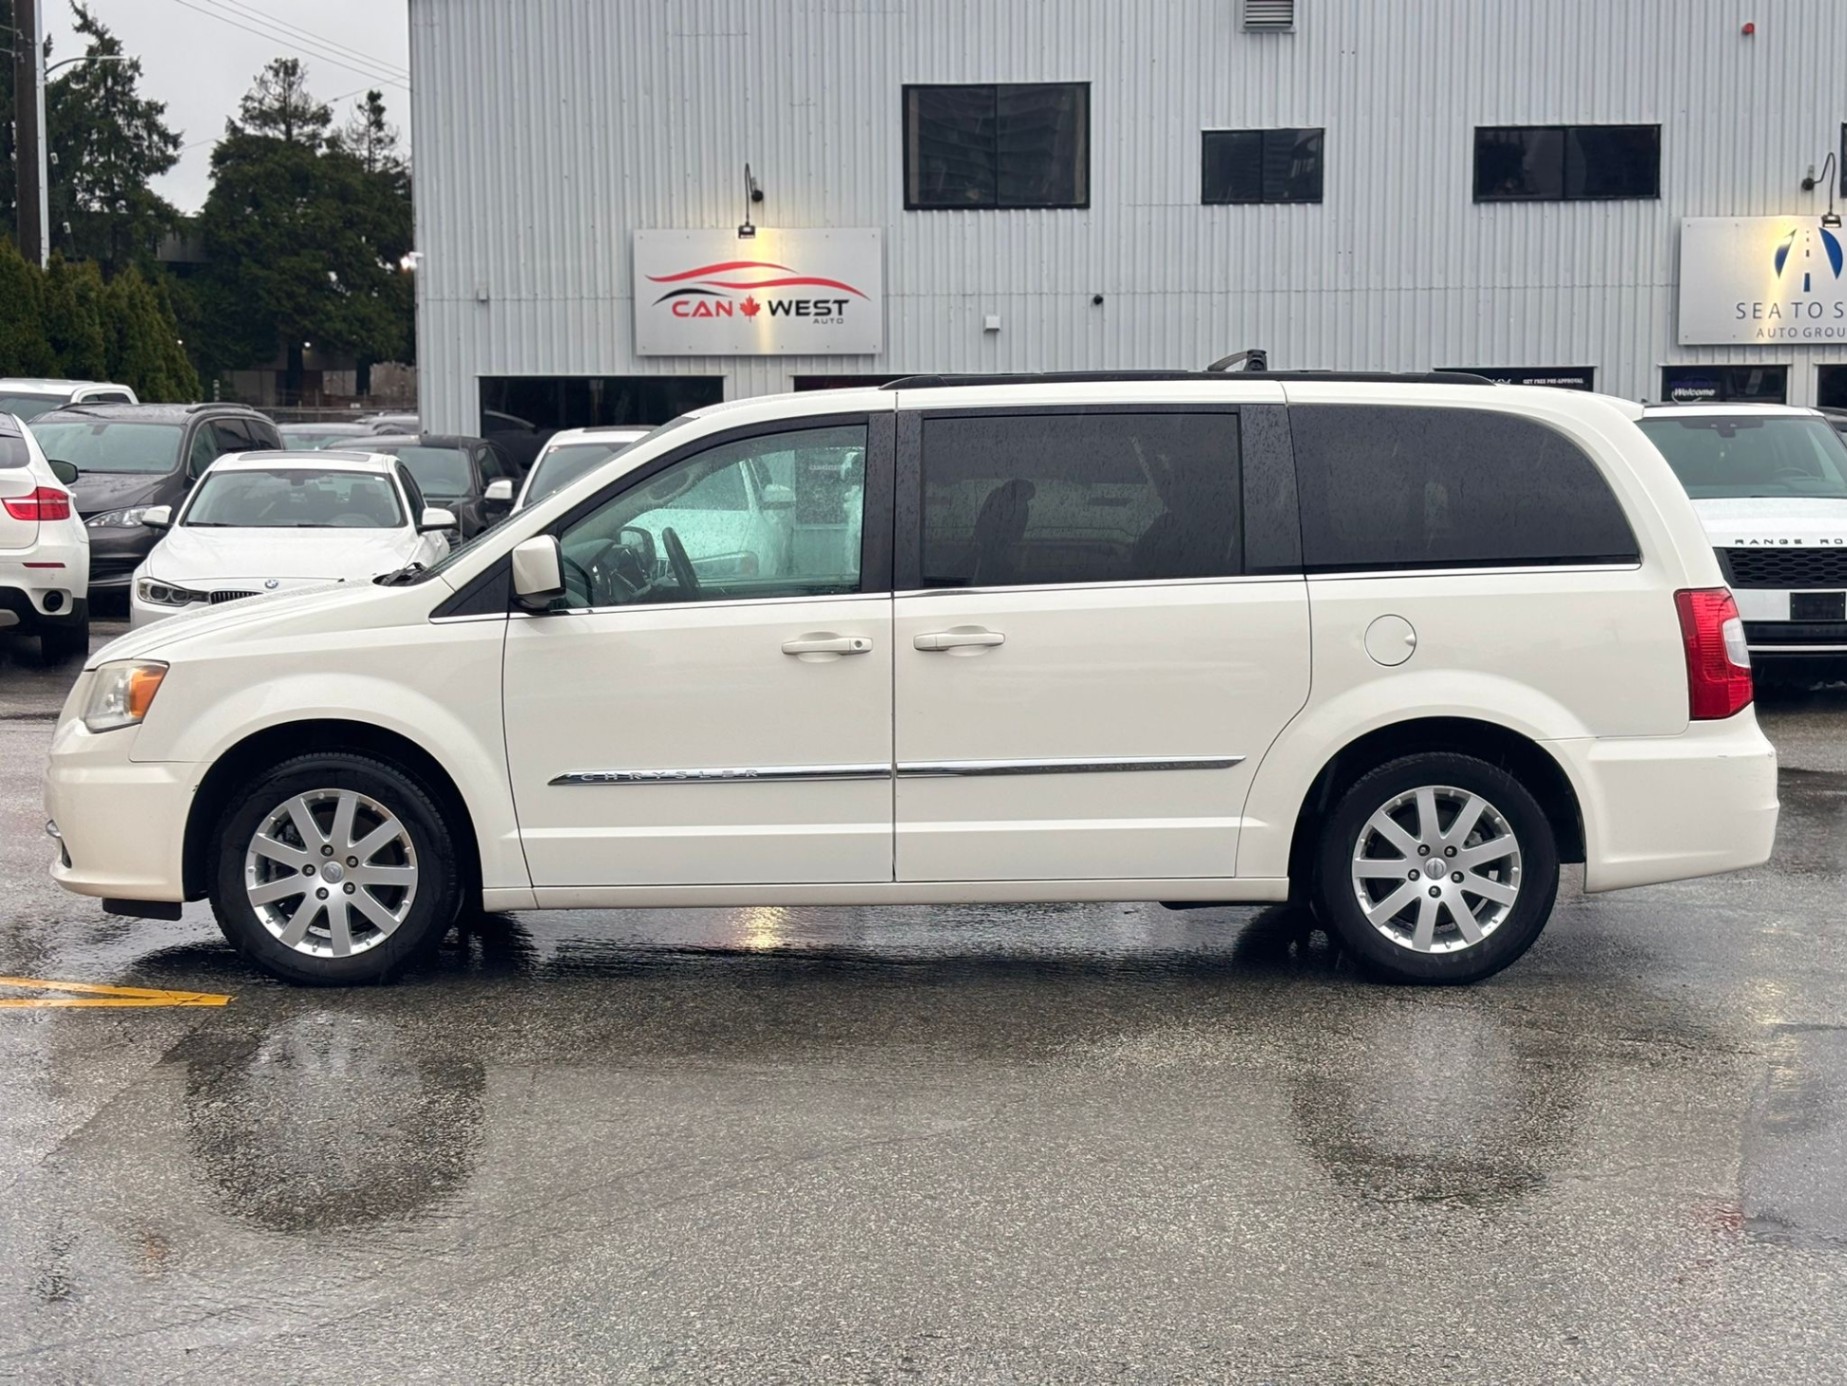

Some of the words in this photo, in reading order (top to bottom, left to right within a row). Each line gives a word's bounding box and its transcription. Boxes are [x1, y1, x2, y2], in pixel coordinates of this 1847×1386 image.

[671, 300, 733, 318] CAN
[767, 300, 850, 317] WEST
[1735, 302, 1782, 320] SEA
[1790, 302, 1823, 319] TO
[1756, 327, 1798, 338] AUTO
[1802, 327, 1846, 338] GROU
[1674, 388, 1716, 397] Welcome
[581, 769, 758, 781] CHRYSLER
